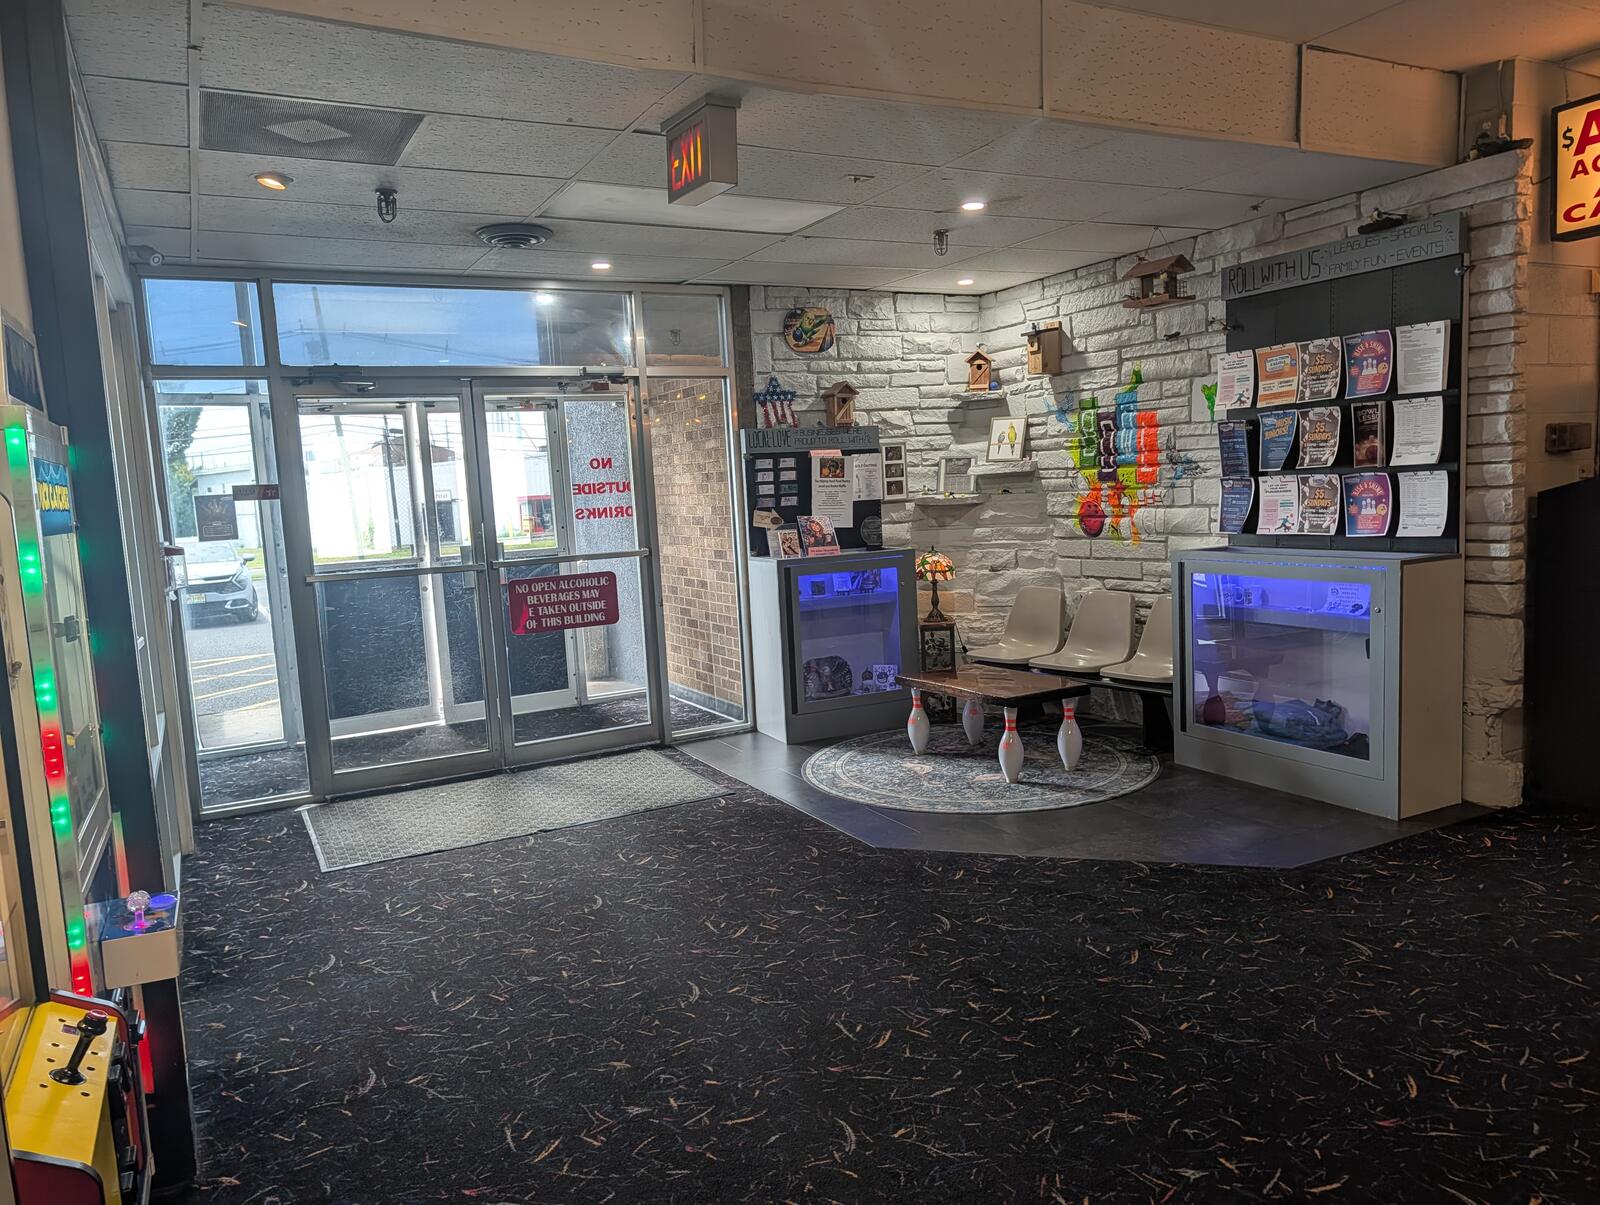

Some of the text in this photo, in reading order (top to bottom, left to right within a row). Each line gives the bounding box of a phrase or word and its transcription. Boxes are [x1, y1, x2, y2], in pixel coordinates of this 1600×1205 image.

[1333, 236, 1380, 255] LEAGUES
[1390, 220, 1443, 242] SPECIALS
[1329, 258, 1361, 275] FAMILY
[1363, 253, 1387, 267] FUN
[1396, 241, 1444, 261] EVENTS
[1229, 250, 1321, 295] ROLL WITH US
[515, 576, 610, 594] NO OPEN ALCOHOLIC
[527, 589, 600, 605] BEVERAGES MAY
[538, 603, 567, 616] TAKEN
[569, 600, 607, 613] OUTSIDE
[526, 612, 606, 630] OF THIS BUILDING
